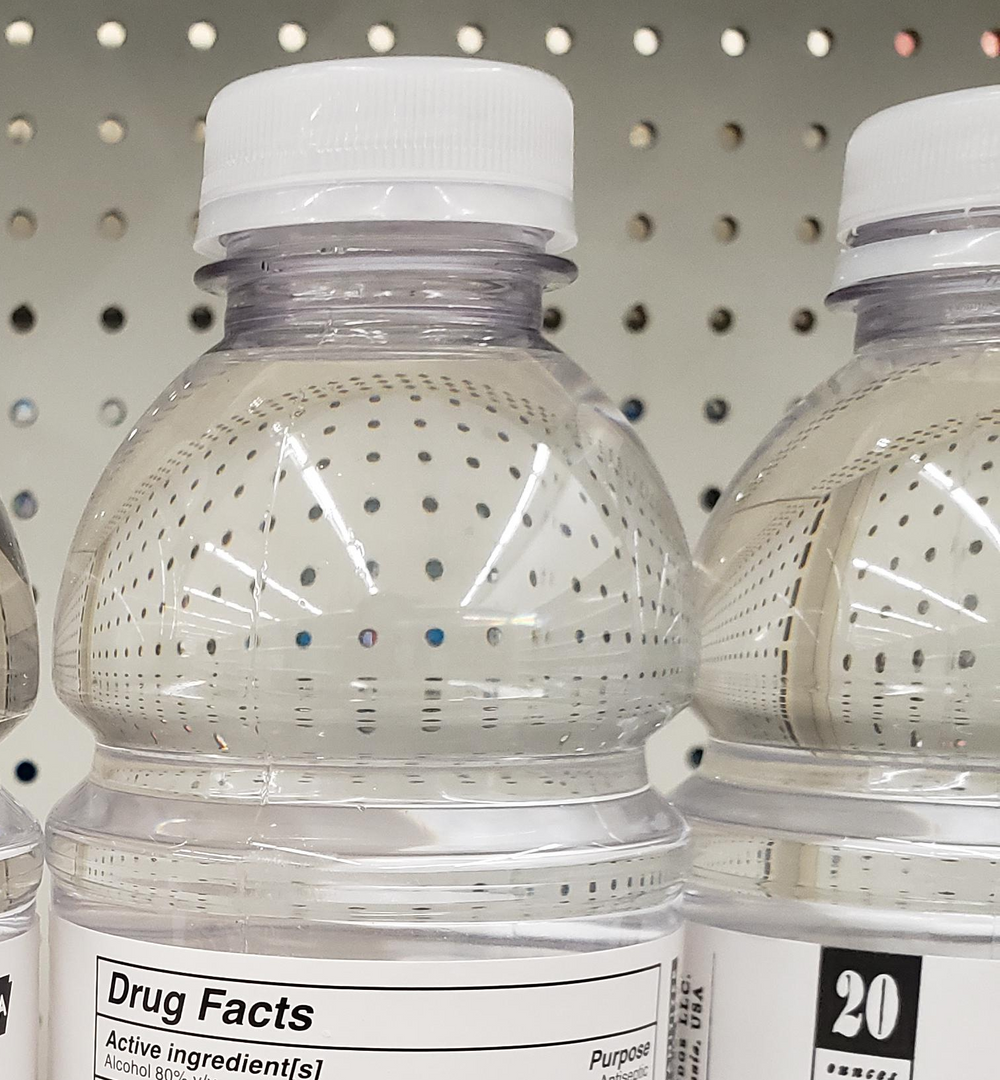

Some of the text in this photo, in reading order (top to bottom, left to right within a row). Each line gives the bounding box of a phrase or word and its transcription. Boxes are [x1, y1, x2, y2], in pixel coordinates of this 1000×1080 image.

[108, 971, 315, 1032] Drug Facts
[691, 986, 704, 1030] USA
[832, 970, 899, 1040] 20
[104, 1054, 151, 1078] Alcohol
[105, 1030, 161, 1059] Active
[589, 1041, 650, 1070] Purpose
